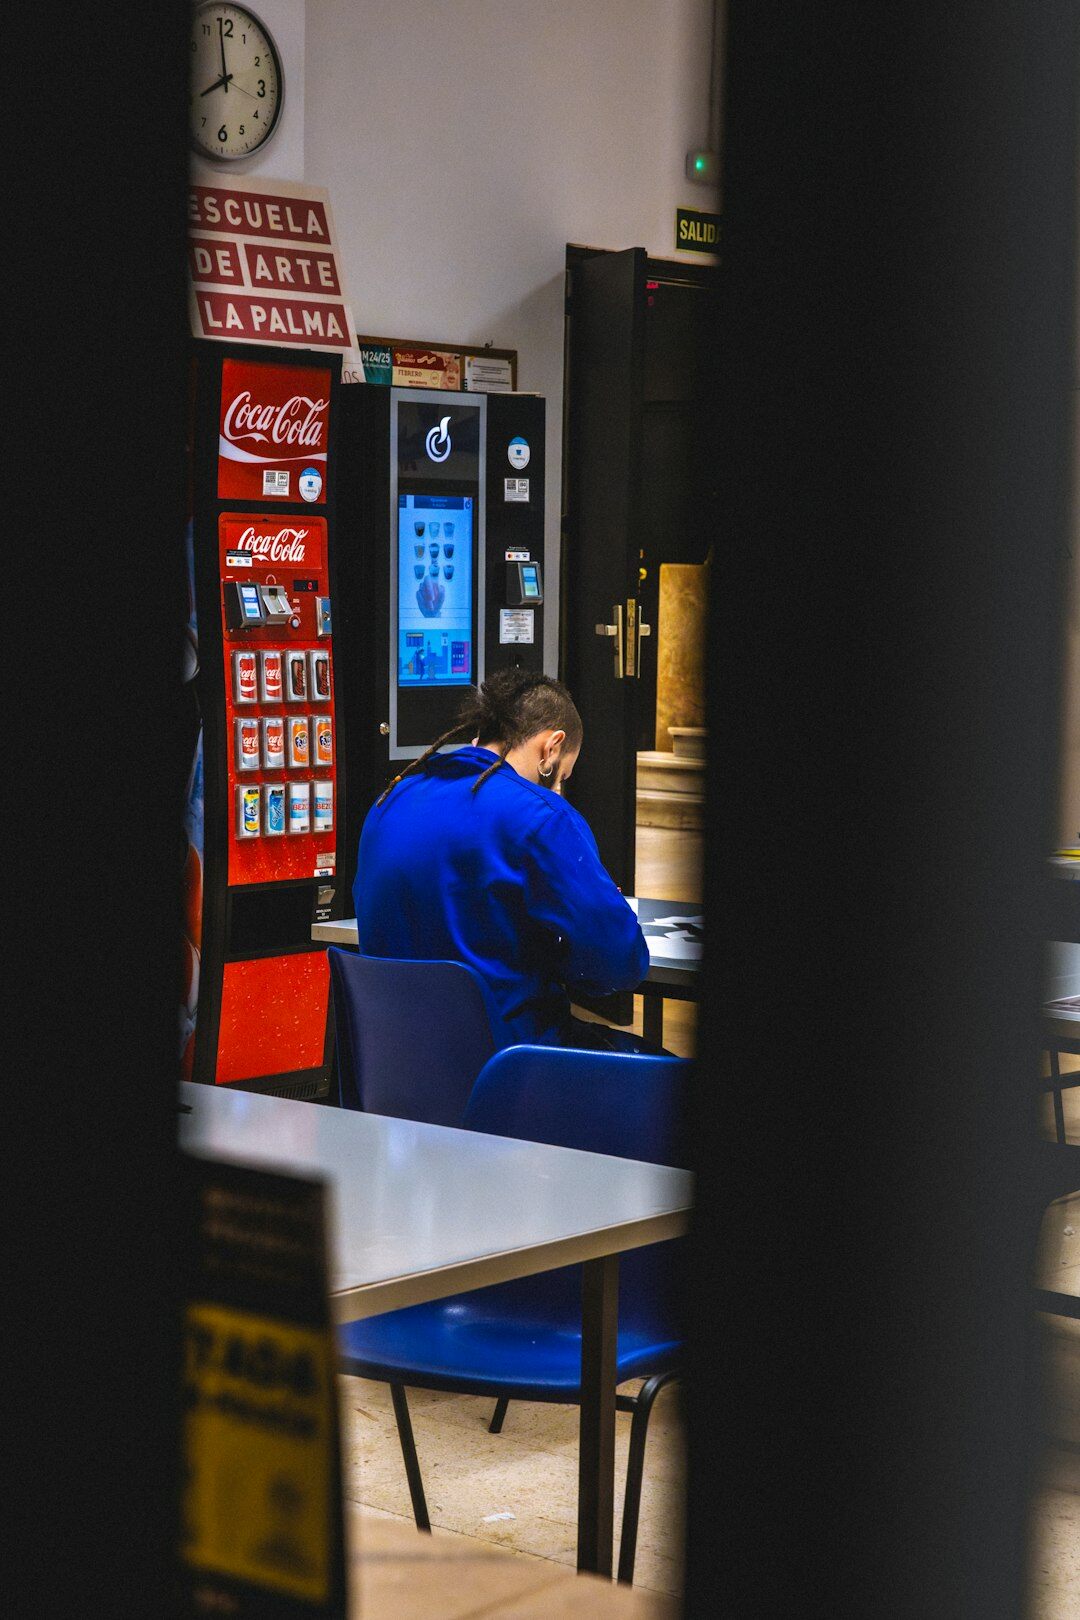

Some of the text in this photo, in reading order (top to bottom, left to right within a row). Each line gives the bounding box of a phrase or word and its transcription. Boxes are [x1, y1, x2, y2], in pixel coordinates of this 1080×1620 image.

[202, 24, 211, 36] 11
[216, 17, 234, 38] 12
[241, 34, 246, 44] 1
[254, 56, 260, 67] 2
[257, 79, 266, 98] 3
[201, 117, 207, 127] 7
[253, 110, 259, 119] 4
[217, 124, 228, 142] 6
[238, 125, 245, 135] 5
[188, 194, 324, 236] ESCUELA
[679, 219, 719, 244] SALID
[194, 247, 335, 288] DE ARTE
[204, 301, 344, 339] LA PALMA
[223, 391, 330, 446] Coca-Cola
[237, 527, 309, 562] Coca-Cola
